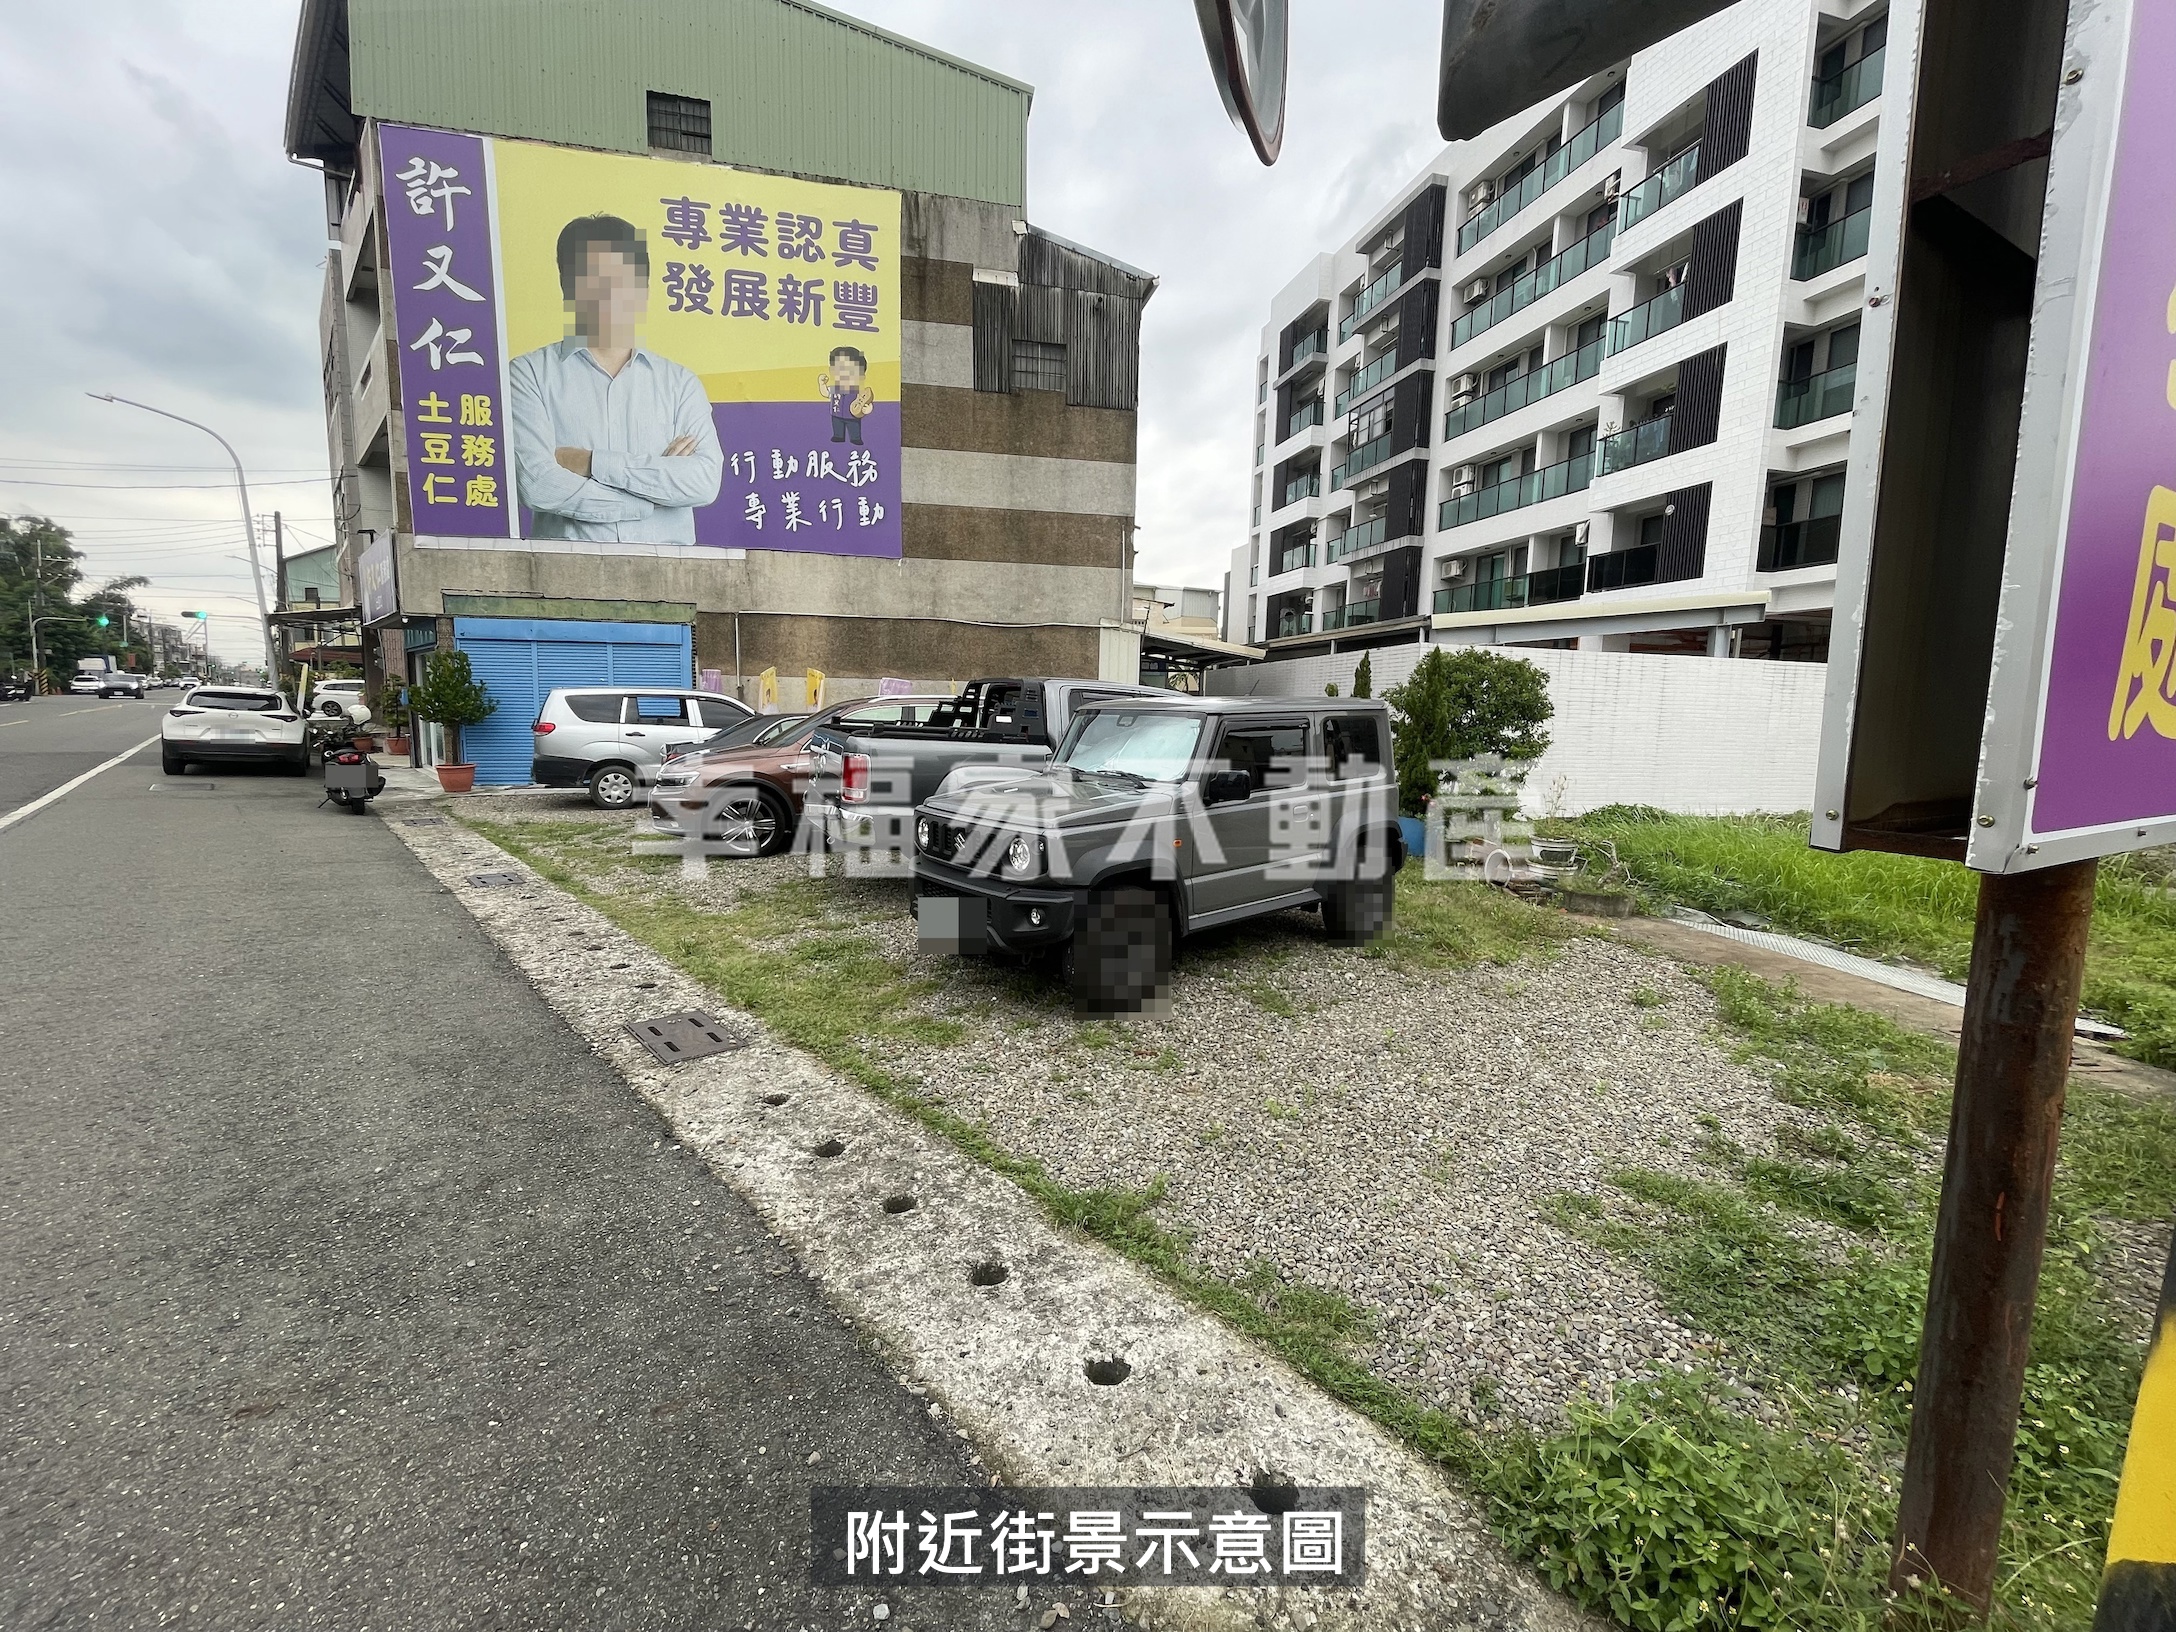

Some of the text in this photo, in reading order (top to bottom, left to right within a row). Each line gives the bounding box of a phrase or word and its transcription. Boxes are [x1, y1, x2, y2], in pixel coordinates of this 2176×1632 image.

[395, 156, 487, 371] 許又仁
[659, 195, 880, 272] 專業認真
[661, 260, 880, 333] 發展新豐
[417, 391, 458, 505] 土豆仁
[460, 393, 499, 508] 服務處
[730, 449, 879, 488] 行動服務
[743, 491, 885, 532] 專業行動
